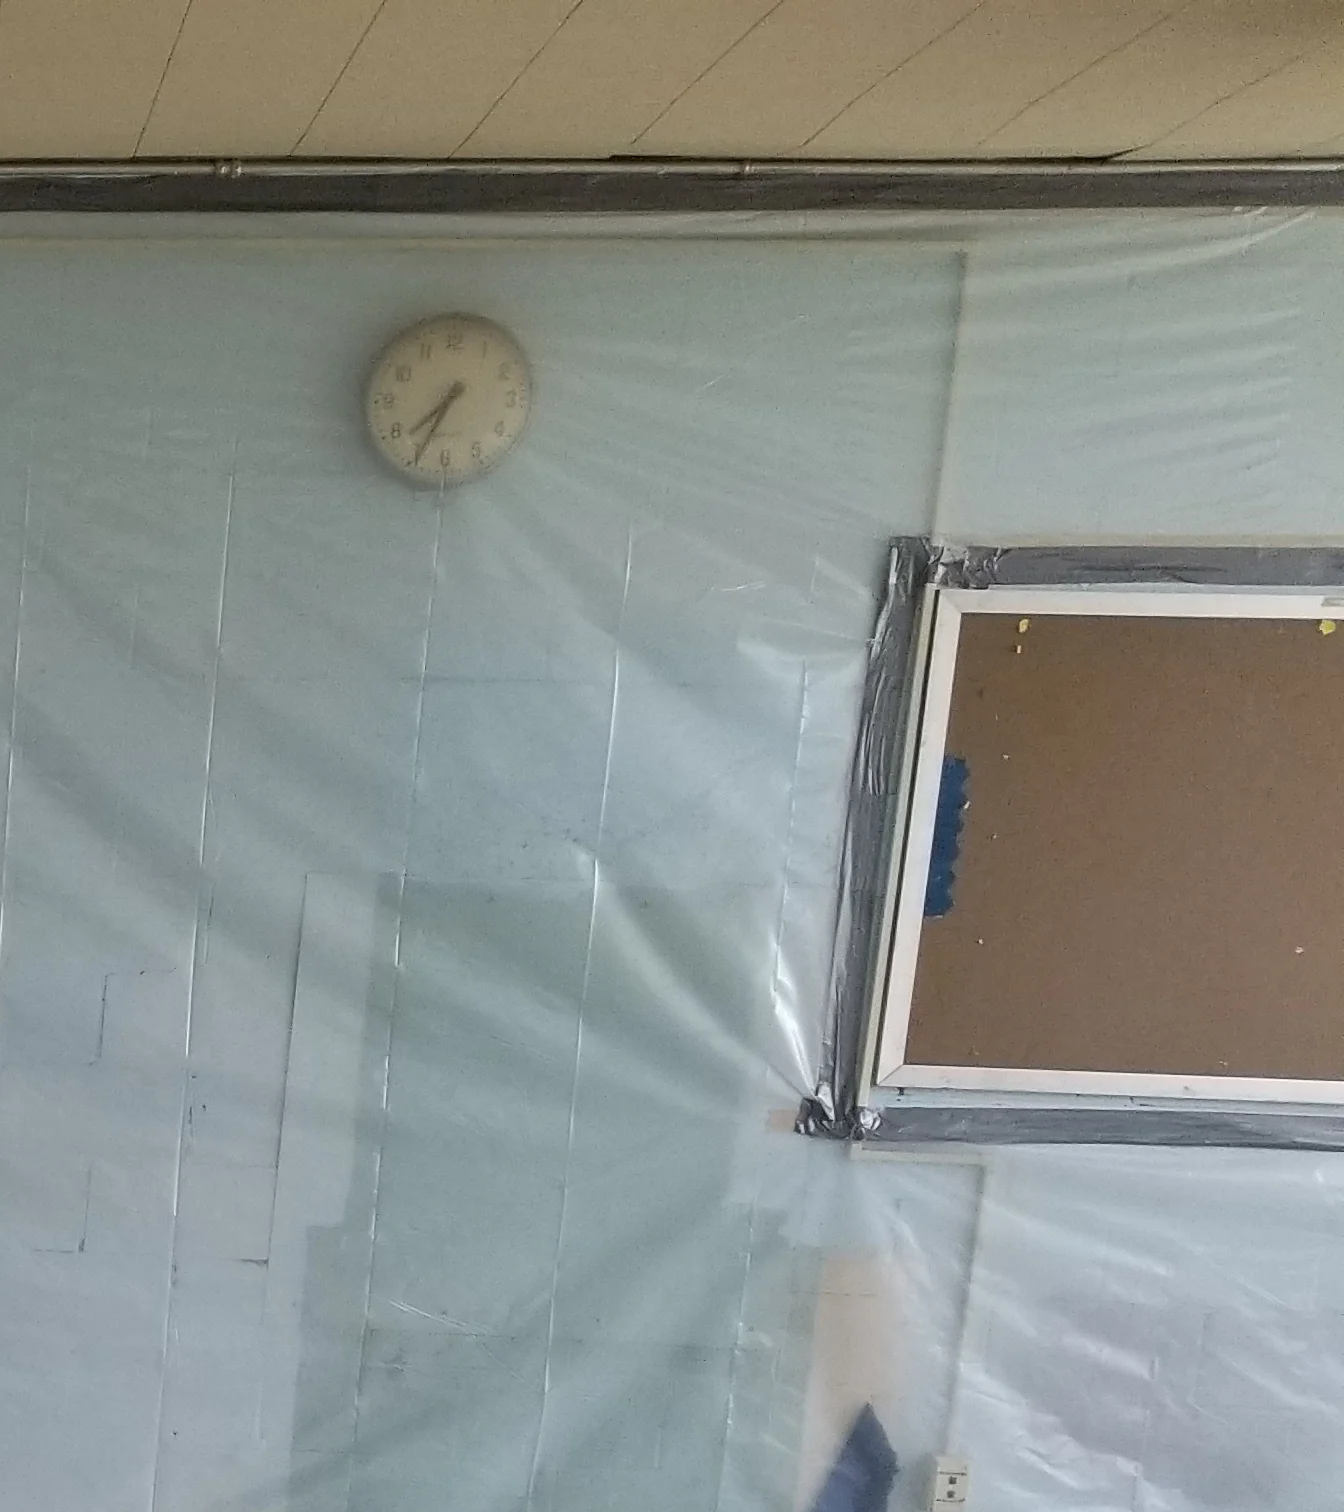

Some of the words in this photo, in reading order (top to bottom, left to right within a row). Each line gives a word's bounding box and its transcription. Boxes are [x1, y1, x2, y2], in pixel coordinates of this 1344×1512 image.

[506, 390, 517, 408] 3
[391, 422, 401, 439] 8
[441, 449, 450, 467] 6
